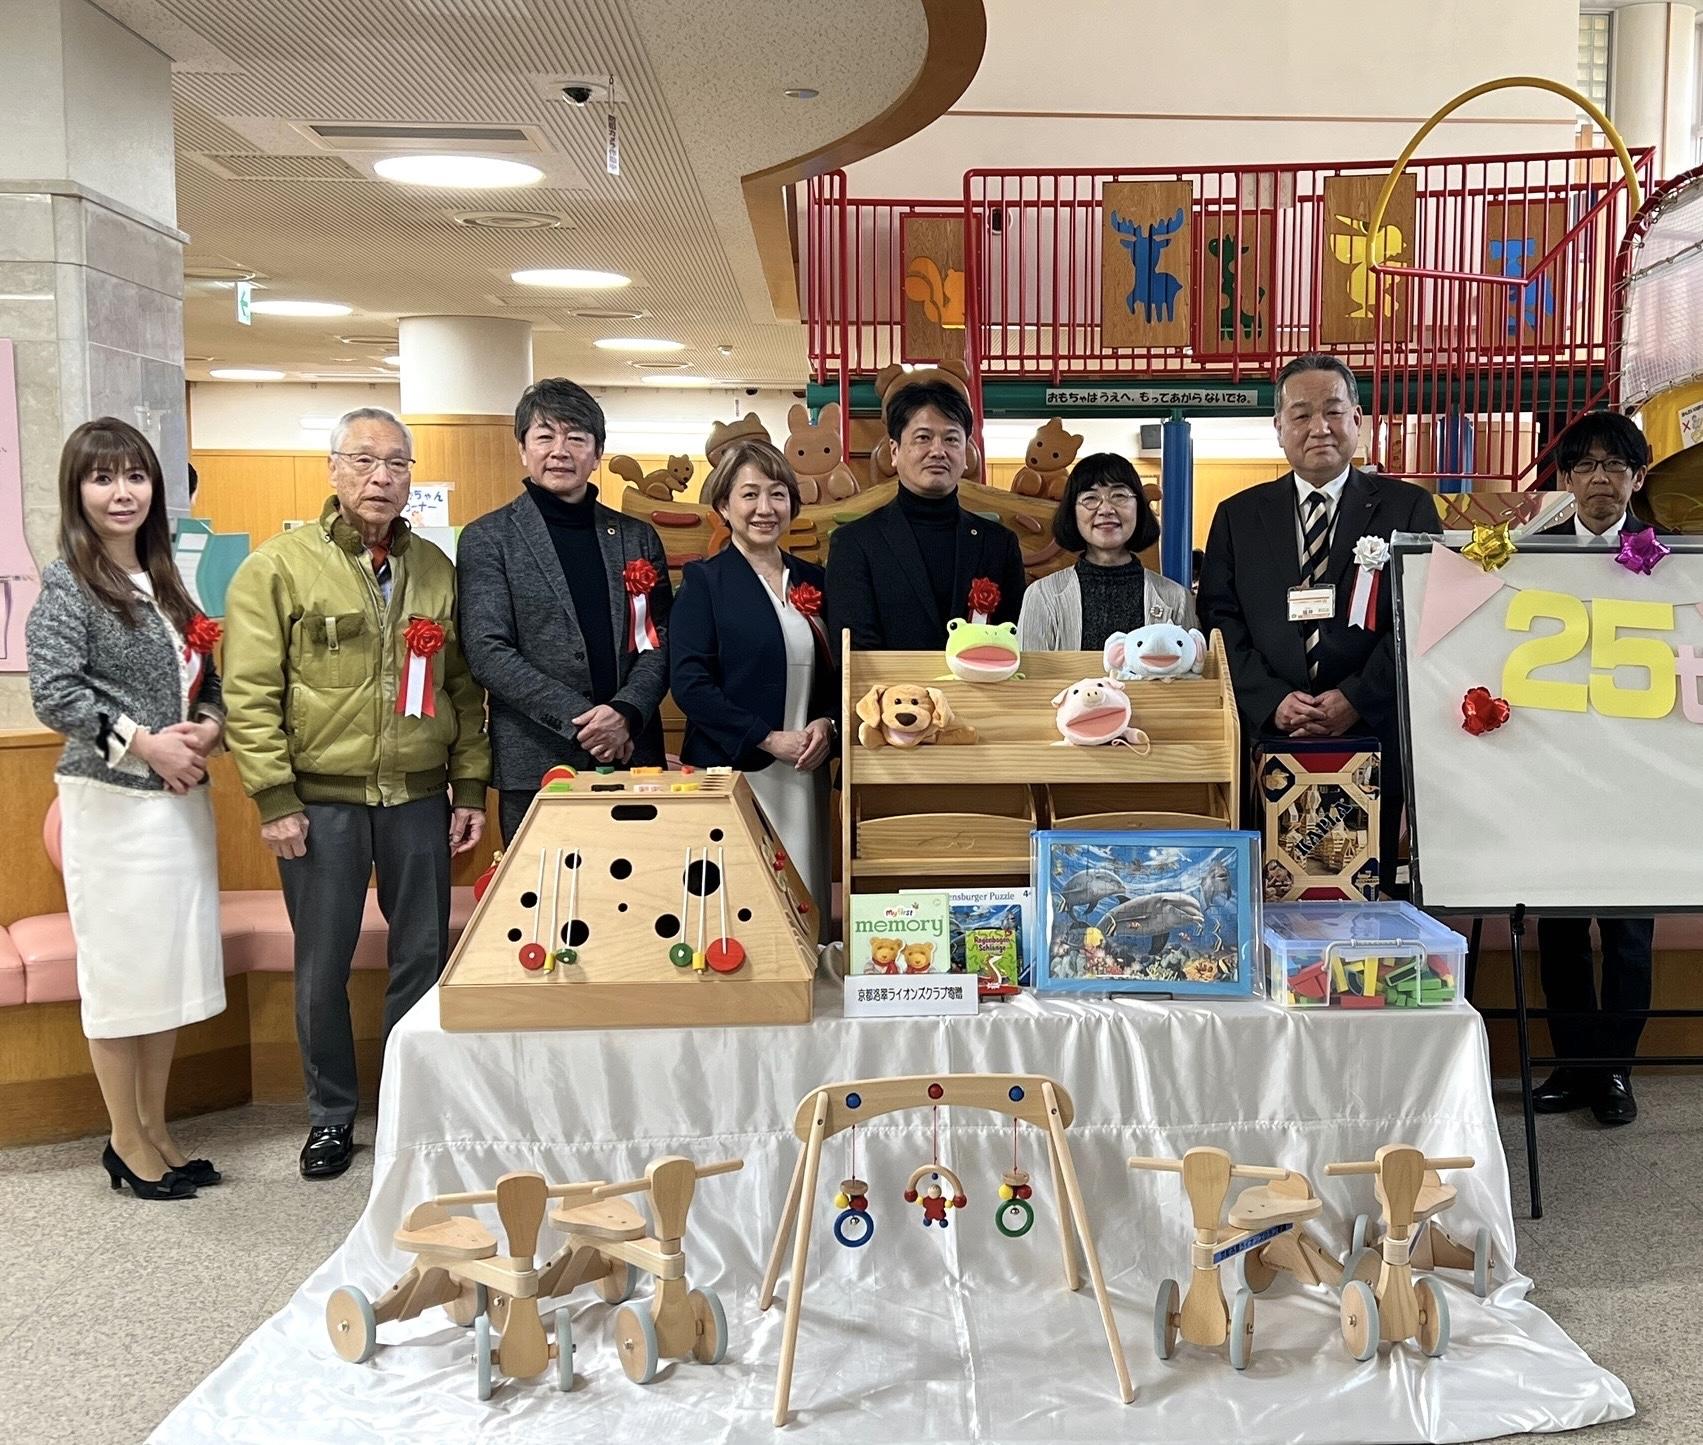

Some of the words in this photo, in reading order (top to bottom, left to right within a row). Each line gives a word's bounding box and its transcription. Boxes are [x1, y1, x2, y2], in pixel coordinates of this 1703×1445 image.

[1295, 801, 1353, 857] KAPLA
[949, 892, 987, 902] nsburger
[990, 891, 1015, 901] Puzzle
[856, 919, 943, 937] memory
